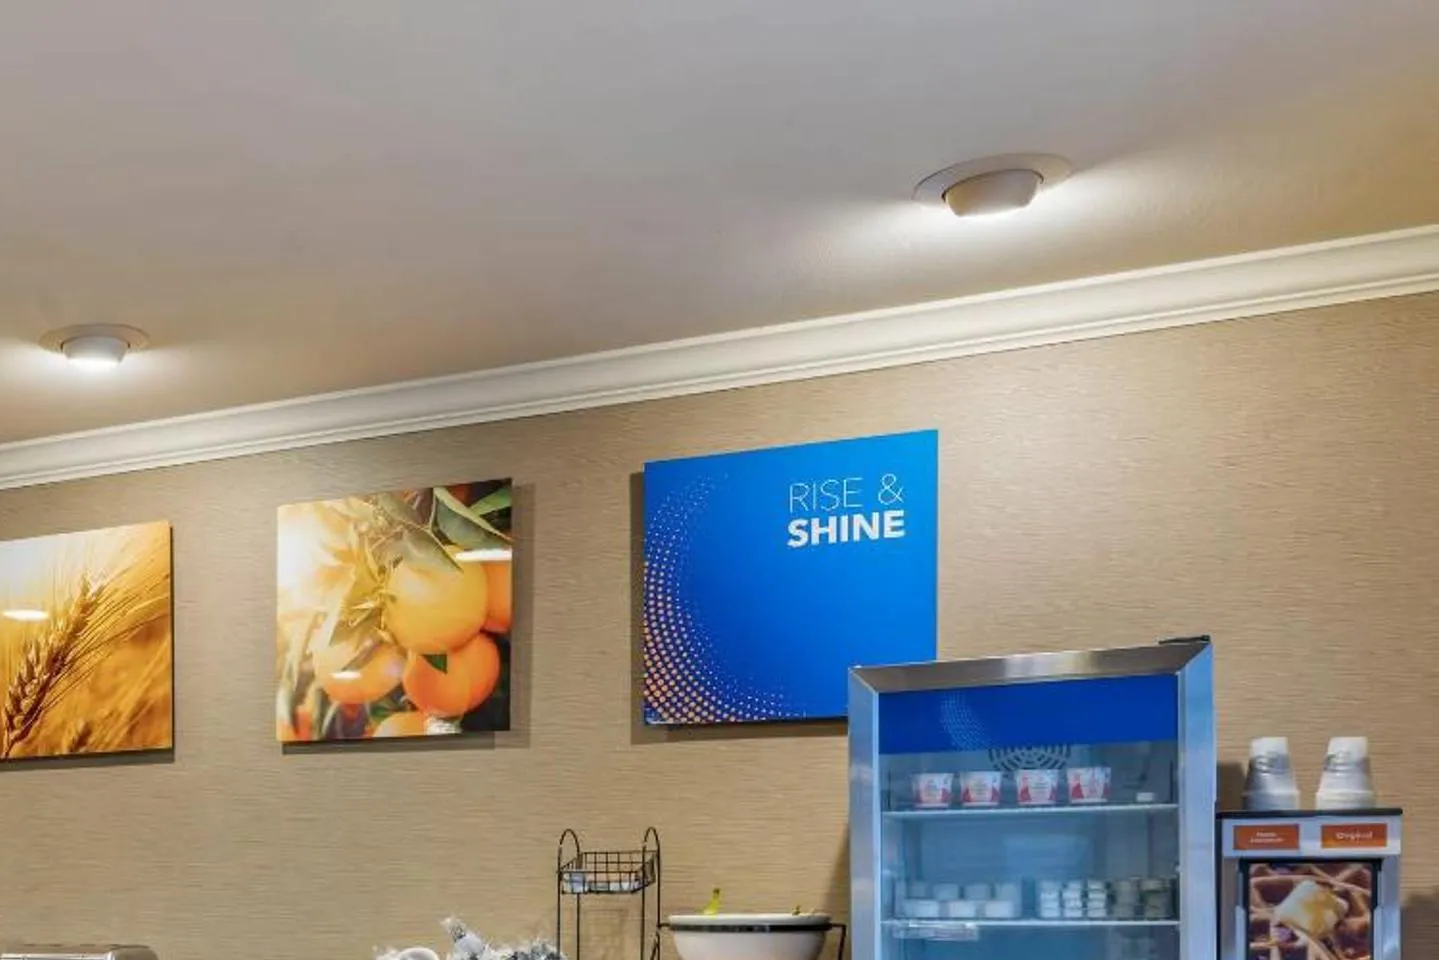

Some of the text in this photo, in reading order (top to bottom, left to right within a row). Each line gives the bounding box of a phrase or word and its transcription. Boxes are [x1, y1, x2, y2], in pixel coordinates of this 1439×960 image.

[789, 473, 905, 514] RISE &
[787, 509, 906, 548] SHINE
